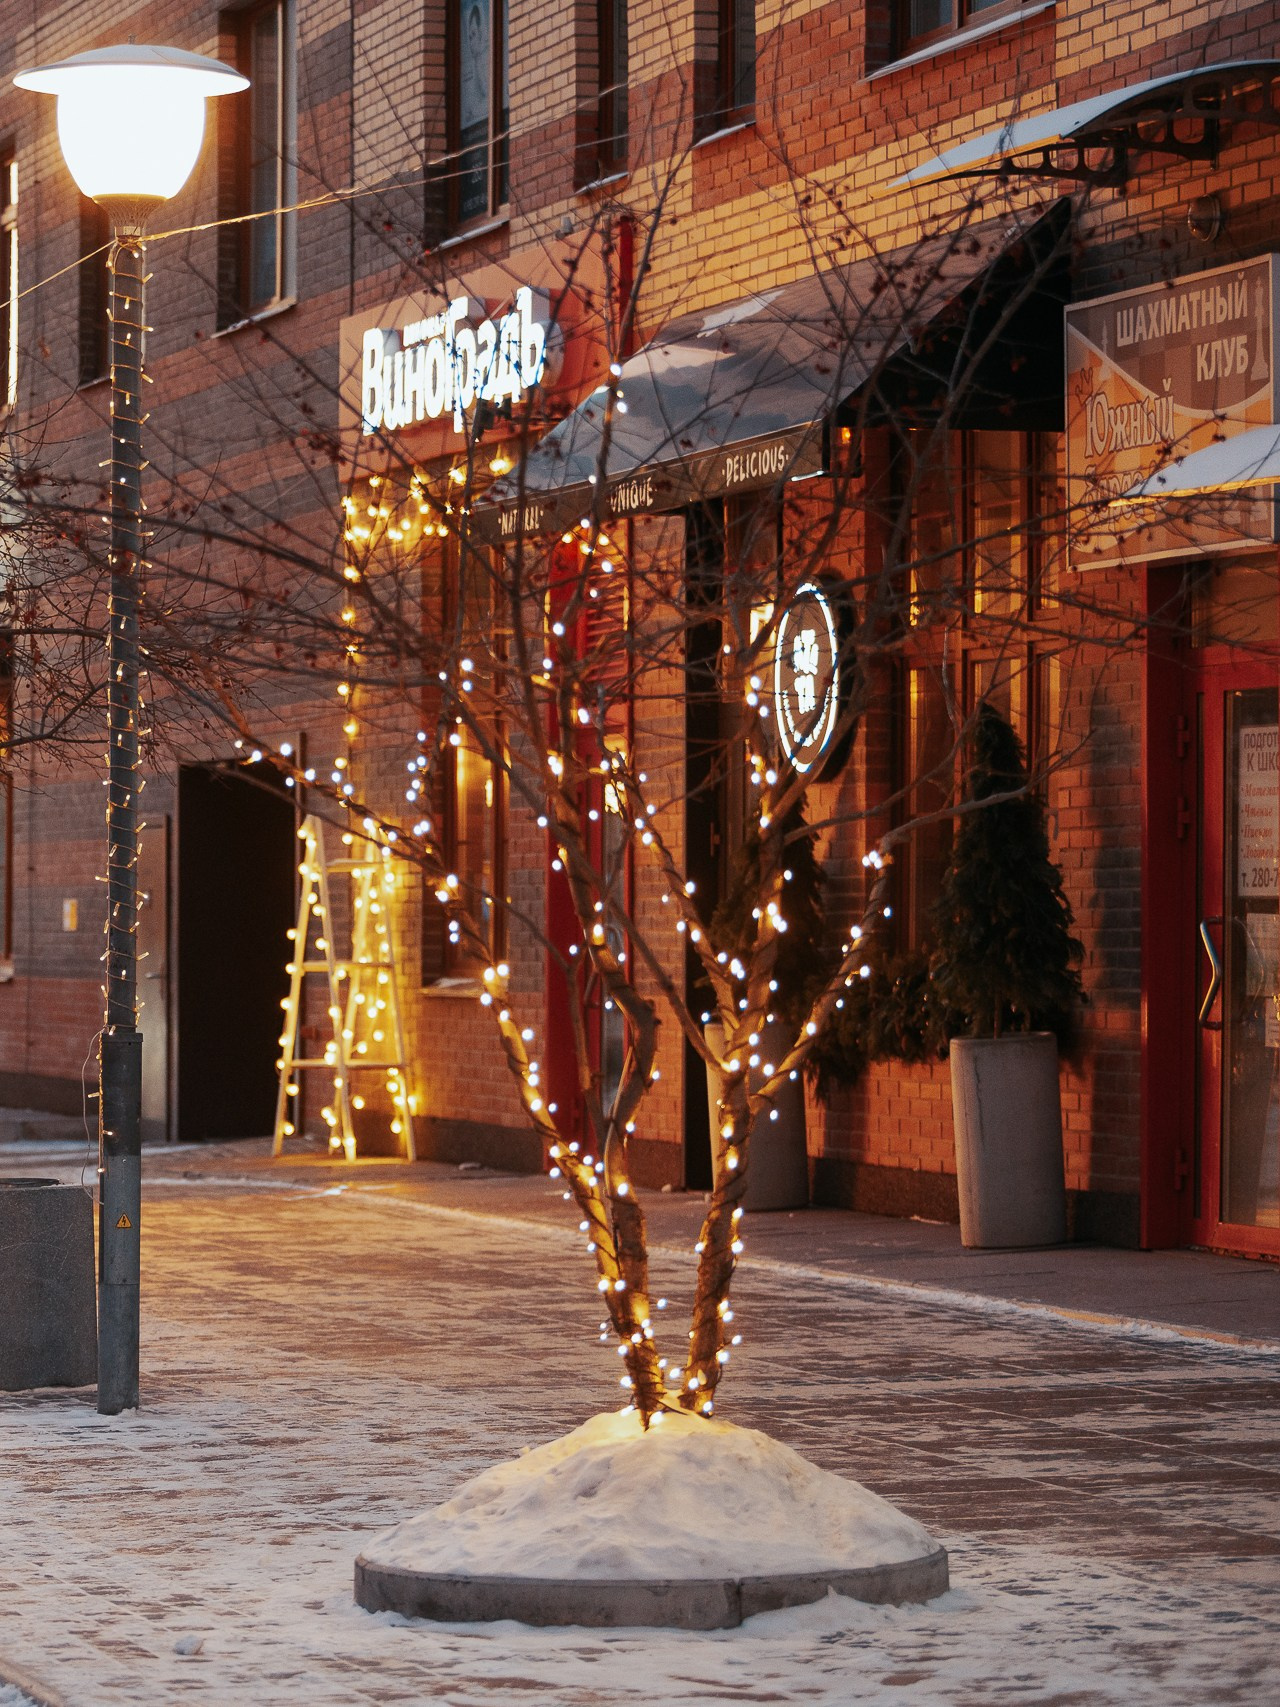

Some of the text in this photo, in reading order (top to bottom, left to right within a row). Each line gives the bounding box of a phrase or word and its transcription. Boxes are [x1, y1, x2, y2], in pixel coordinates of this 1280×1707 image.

[1116, 272, 1248, 348] ШАХМАТНЫЙ
[1197, 335, 1249, 382] КЛУБ
[1084, 378, 1175, 458] Южный
[726, 445, 785, 487] DELICIOUS
[501, 506, 541, 536] NATRAL
[1247, 752, 1255, 772] К
